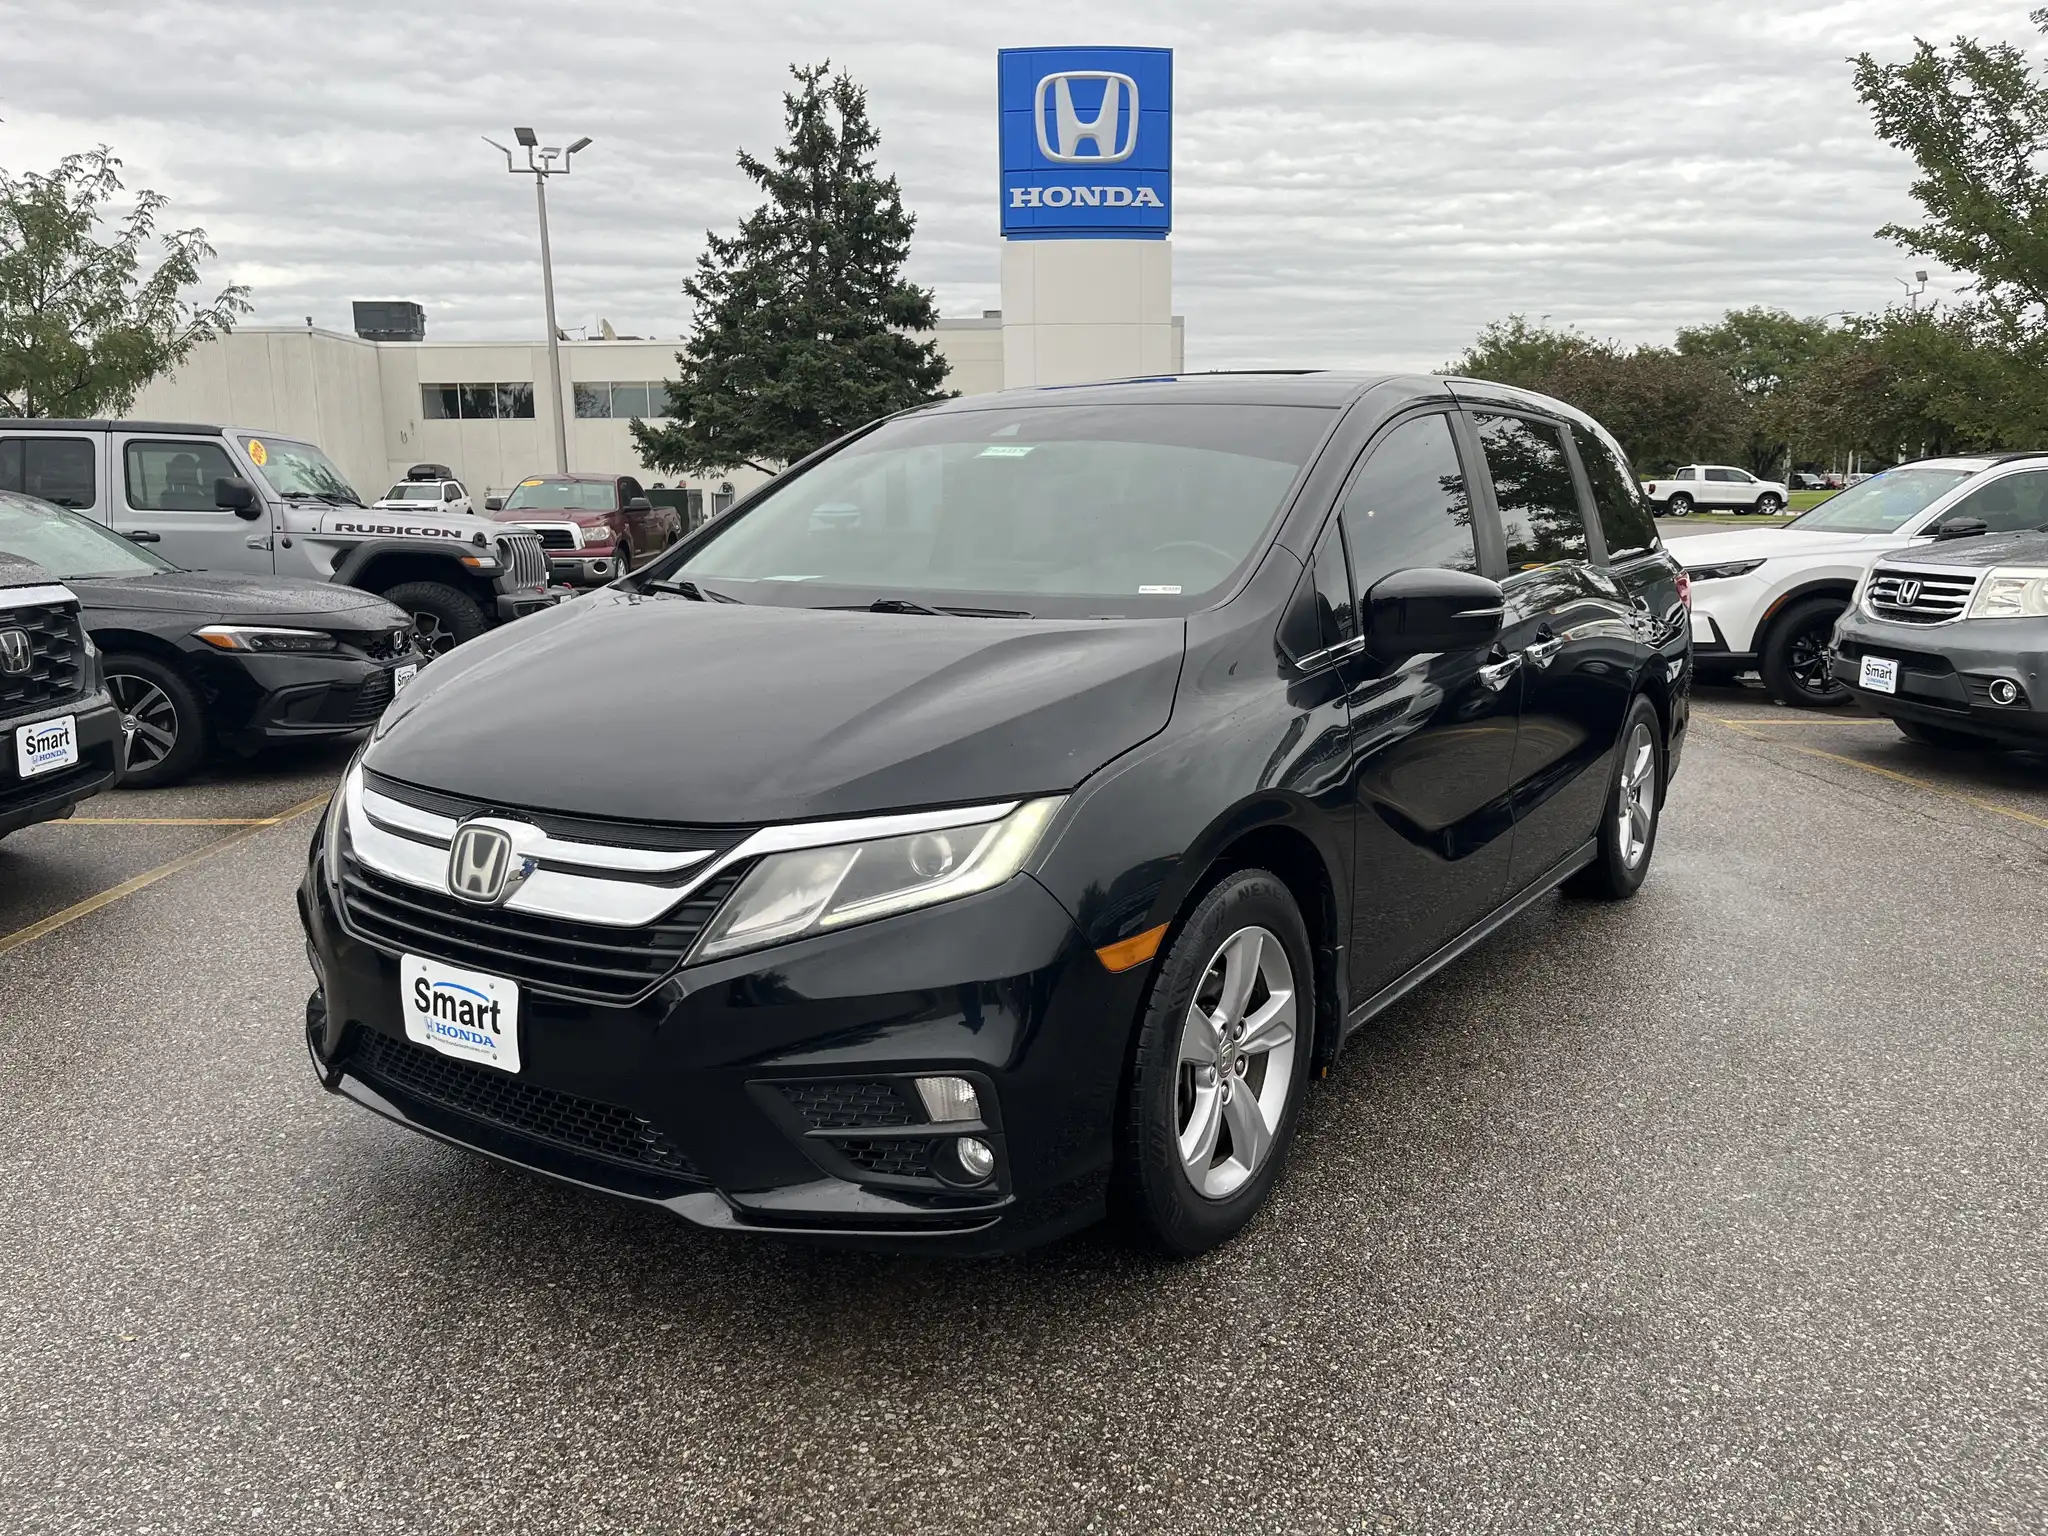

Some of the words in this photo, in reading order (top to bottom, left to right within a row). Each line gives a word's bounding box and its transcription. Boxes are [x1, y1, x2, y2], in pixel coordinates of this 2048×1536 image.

[1009, 186, 1165, 209] HONDA
[334, 523, 462, 539] RUBICON
[1864, 663, 1892, 680] Smart
[25, 727, 70, 756] Smart
[38, 748, 67, 762] HONDA
[414, 976, 502, 1036] Smart
[435, 1022, 497, 1049] HONDA
